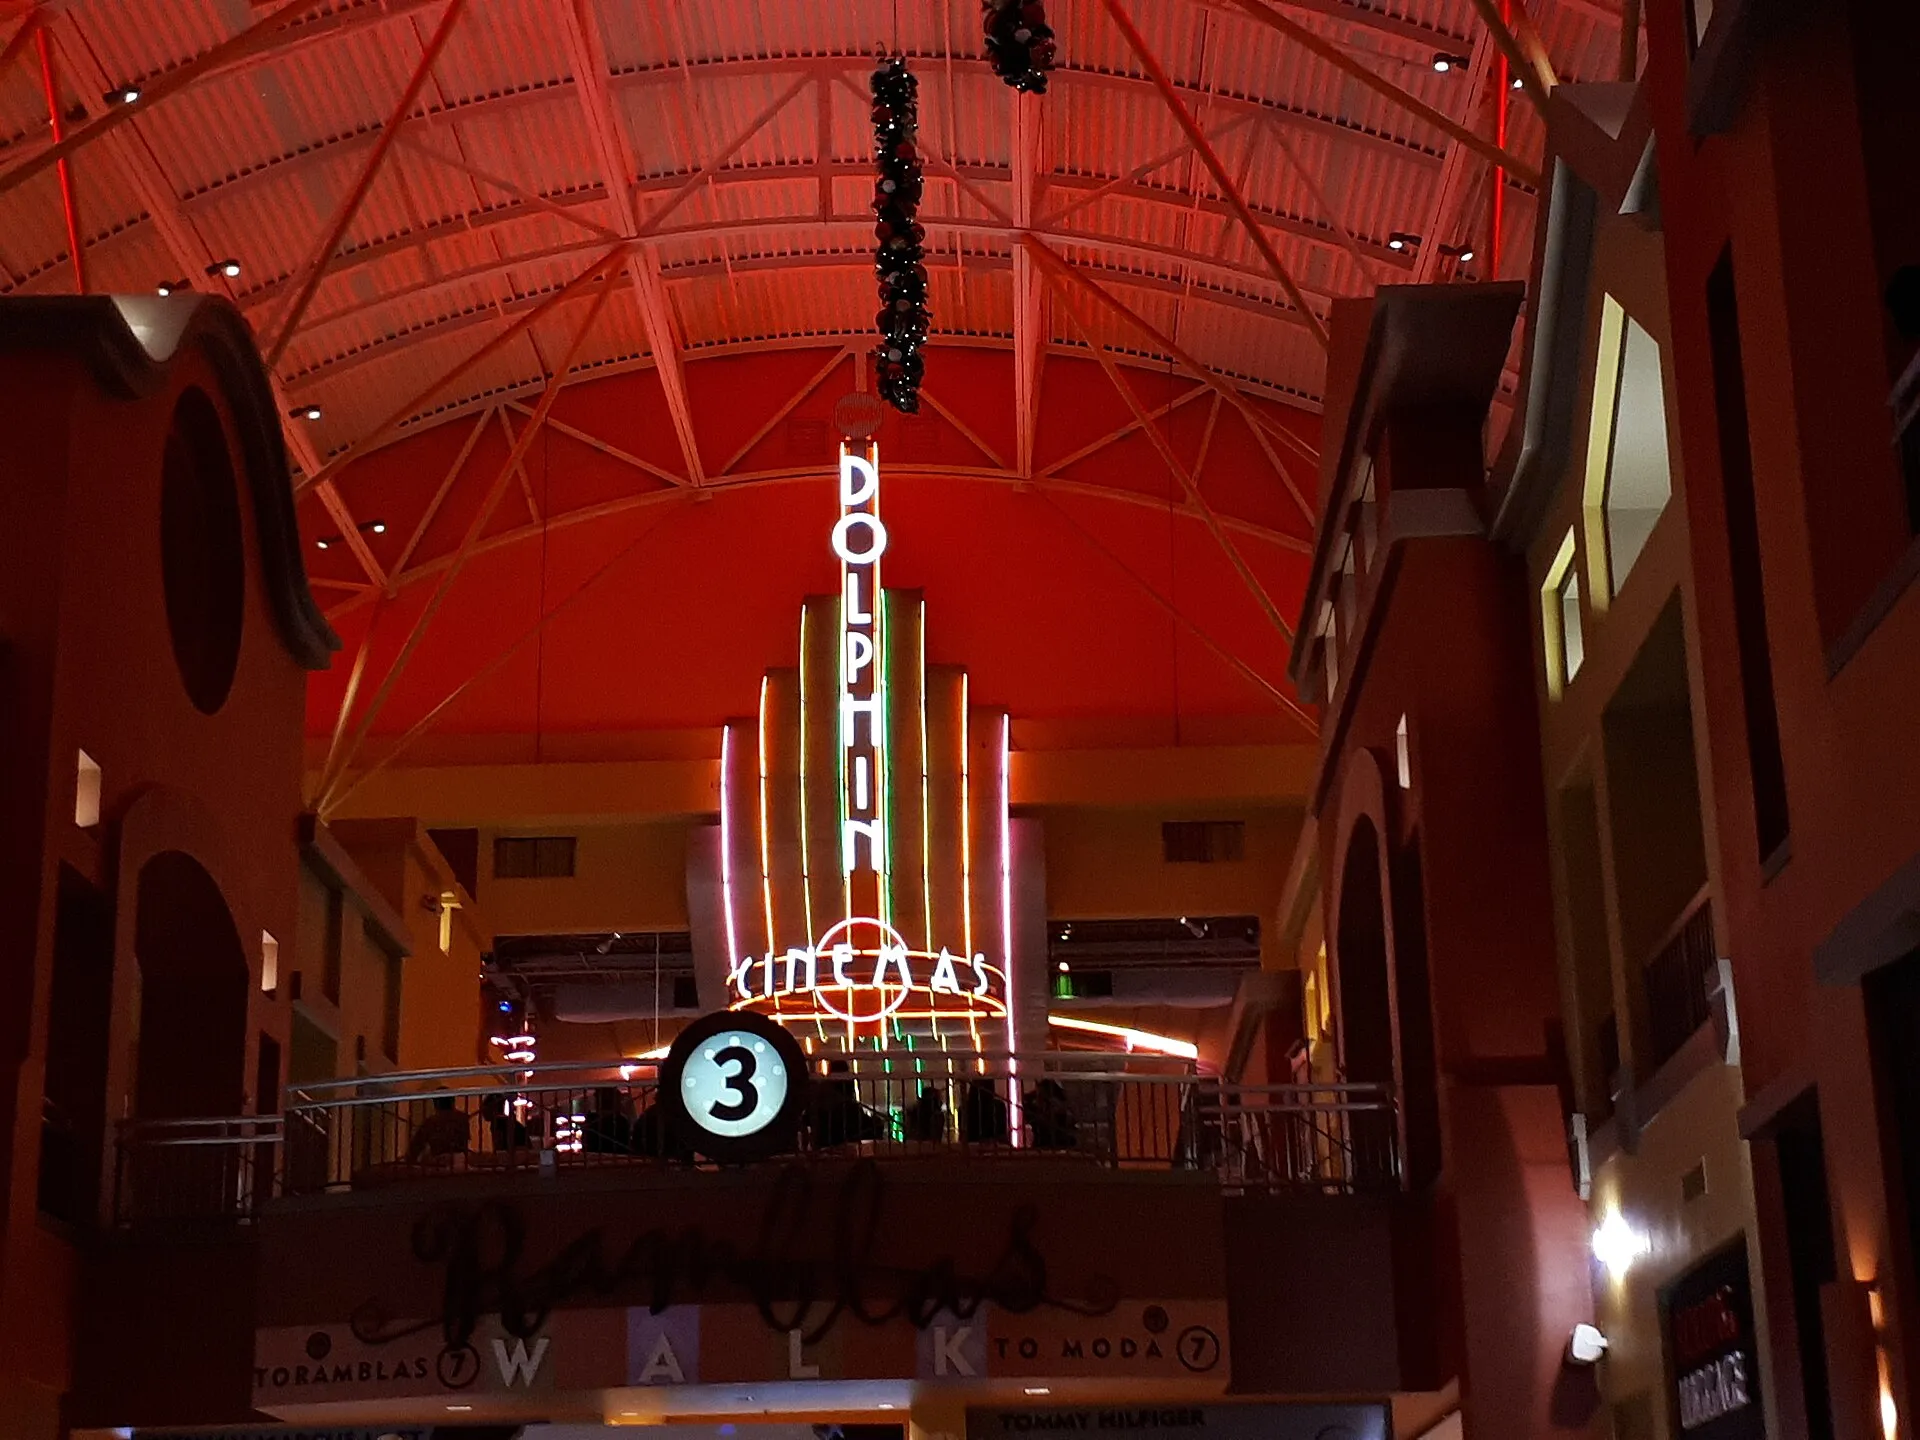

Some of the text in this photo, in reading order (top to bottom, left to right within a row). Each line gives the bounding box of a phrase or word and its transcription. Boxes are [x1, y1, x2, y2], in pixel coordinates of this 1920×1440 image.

[832, 455, 888, 874] DOLPHIN
[736, 942, 990, 998] CINEMAS
[708, 1046, 758, 1121] 3
[993, 1337, 1038, 1359] TO
[1061, 1337, 1163, 1359] MODA
[1000, 1408, 1206, 1432] TOMMY HILFIGER
